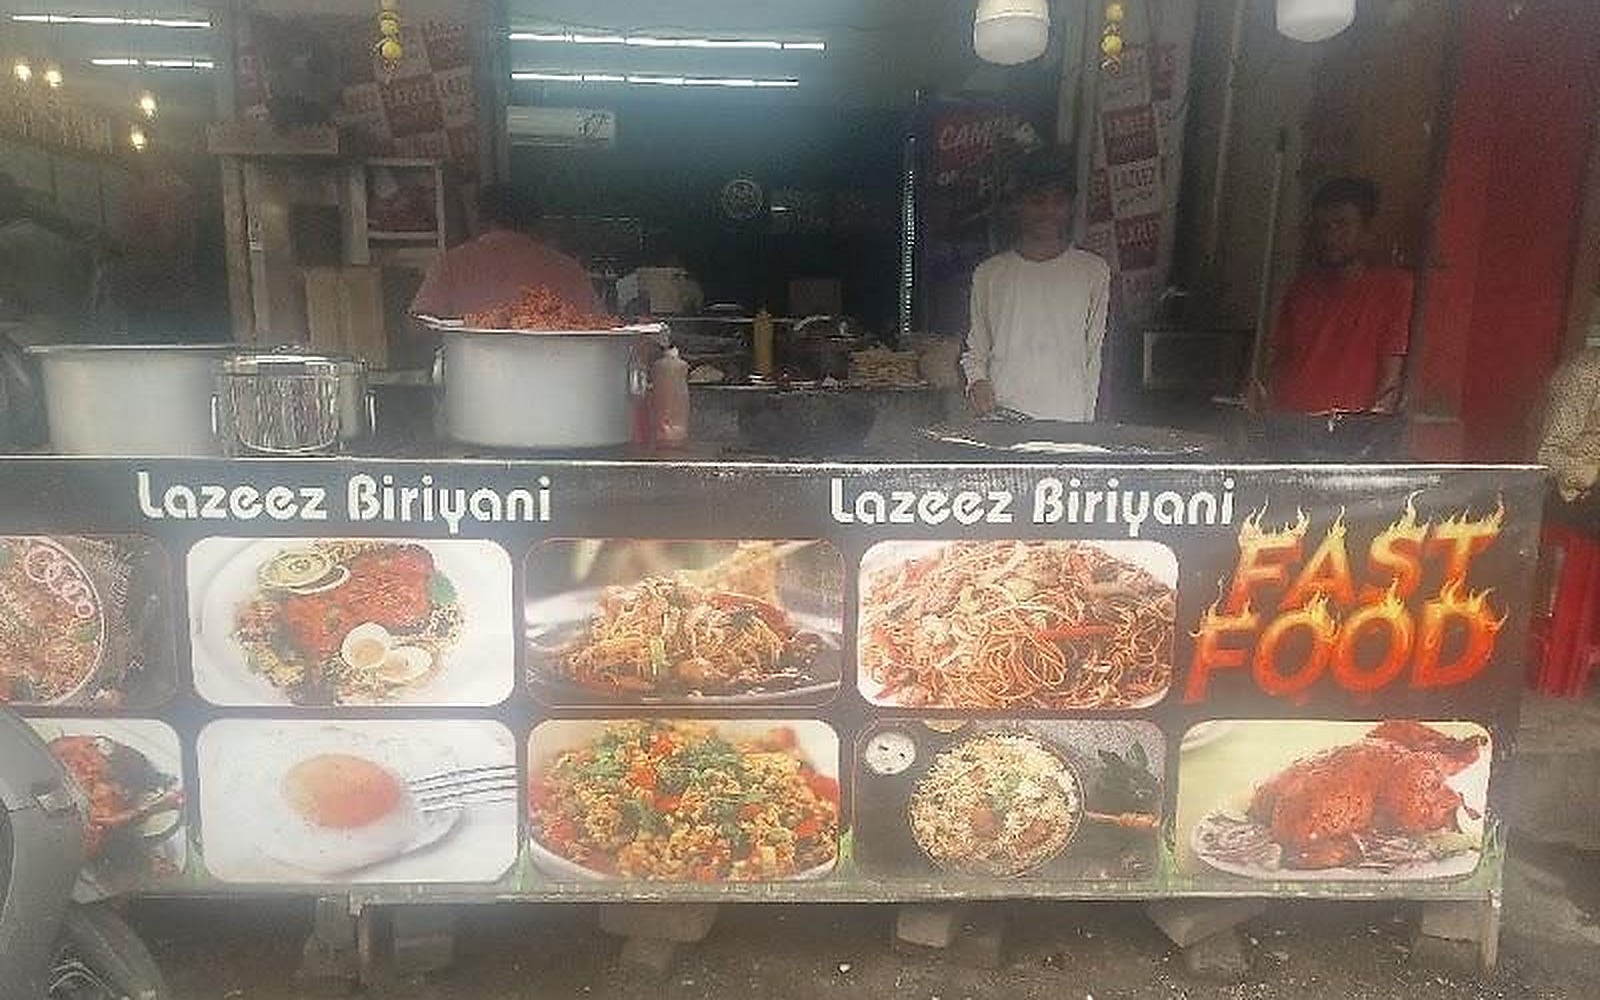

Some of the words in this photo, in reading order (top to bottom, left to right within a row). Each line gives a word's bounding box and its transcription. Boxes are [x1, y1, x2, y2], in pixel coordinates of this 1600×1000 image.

[137, 471, 327, 520] Lazeez
[347, 473, 551, 534] Biriyani
[830, 477, 1014, 525] Lazeez
[1032, 477, 1235, 536] Biriyani
[1223, 497, 1504, 616] FAST
[1184, 588, 1502, 704] FOOD
